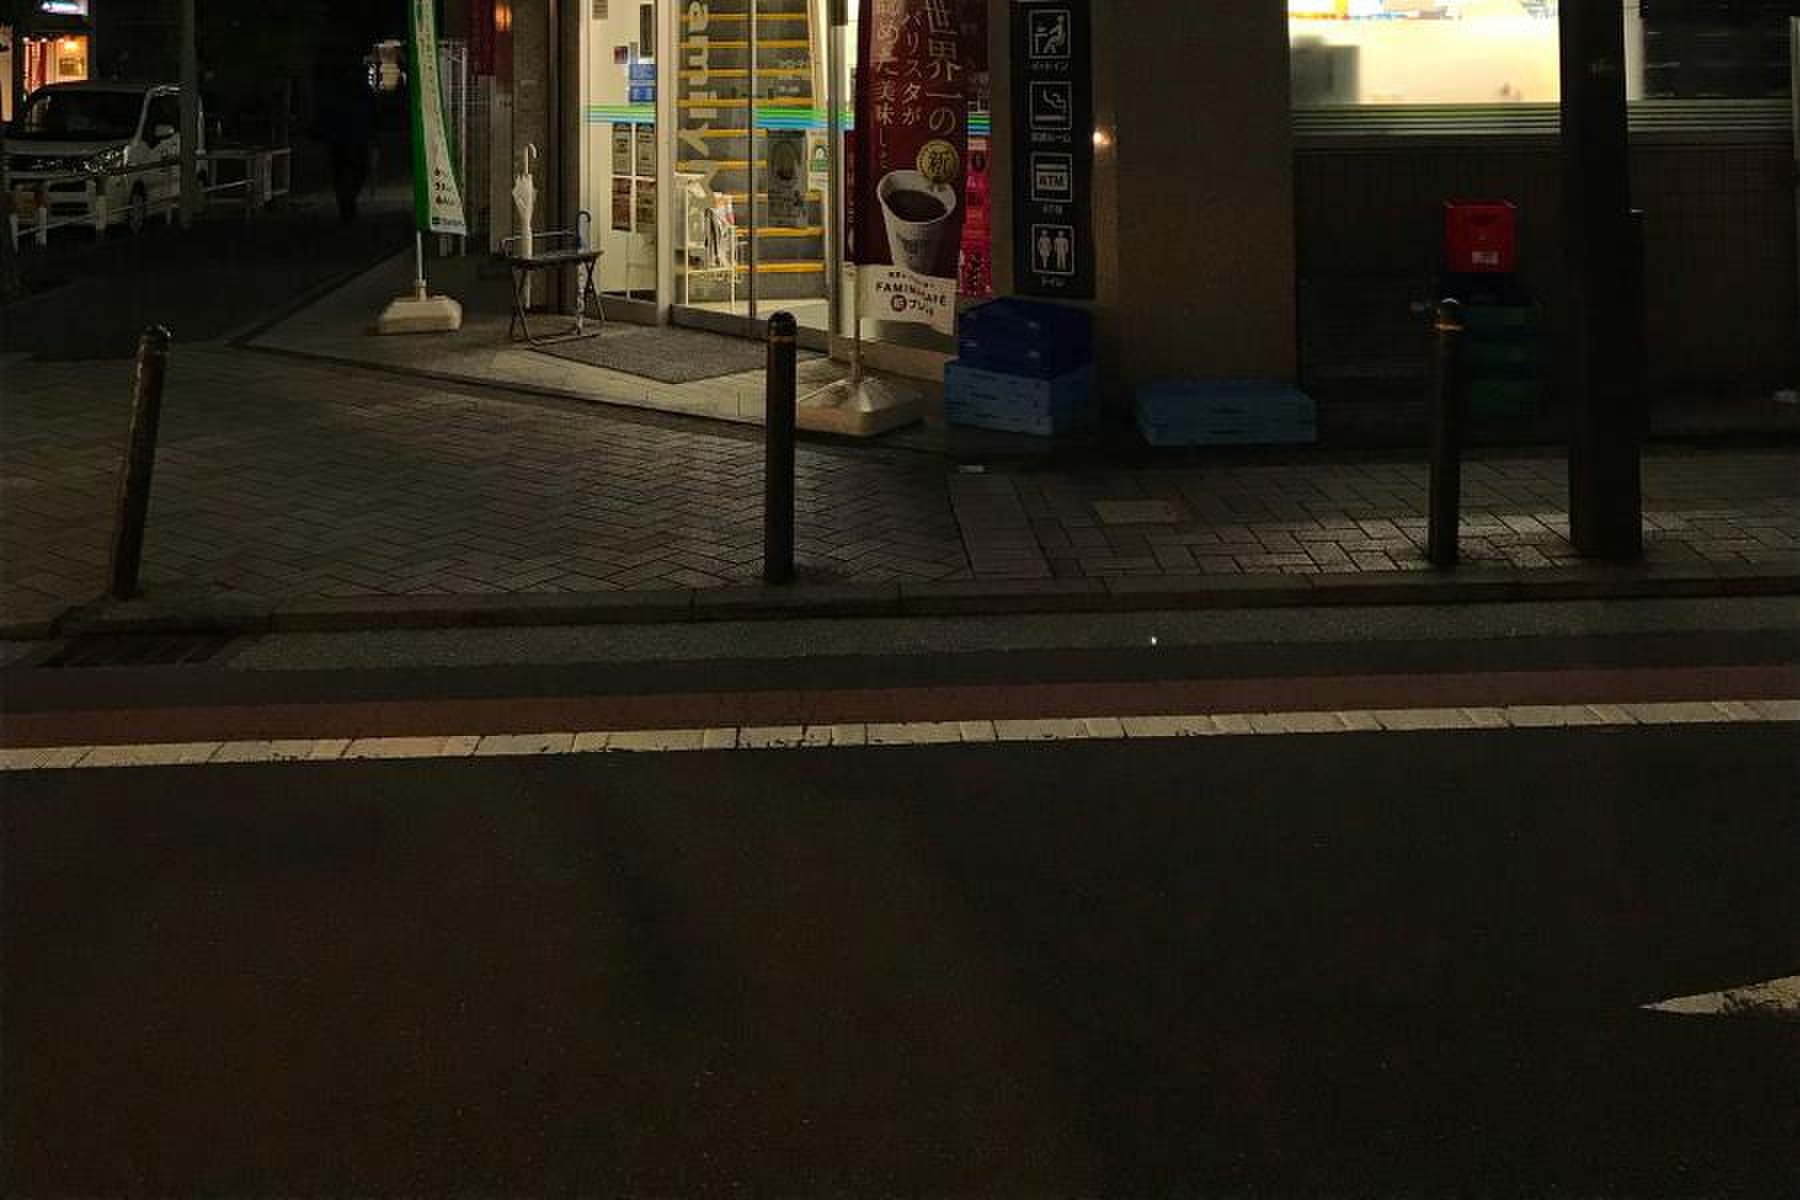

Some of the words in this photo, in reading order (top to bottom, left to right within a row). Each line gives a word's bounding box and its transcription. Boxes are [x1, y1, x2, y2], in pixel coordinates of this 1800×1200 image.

[899, 11, 925, 127] バリスタが
